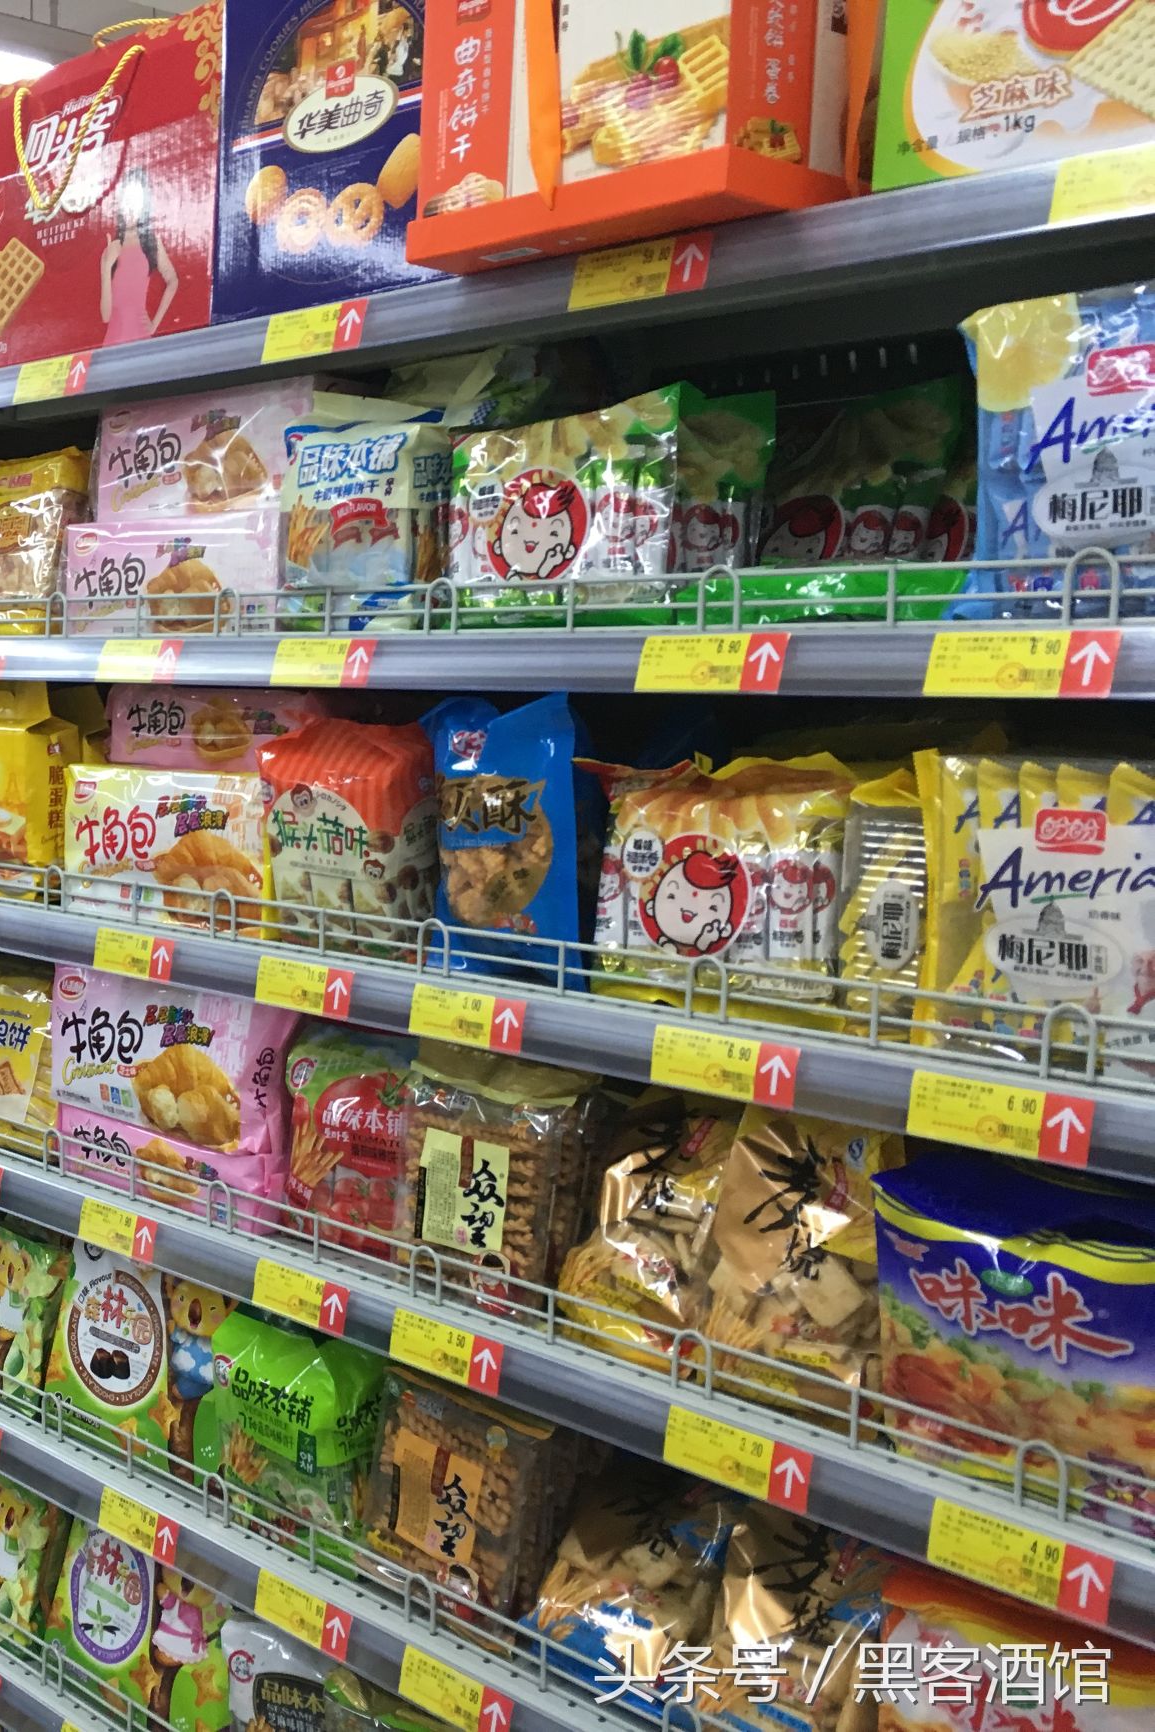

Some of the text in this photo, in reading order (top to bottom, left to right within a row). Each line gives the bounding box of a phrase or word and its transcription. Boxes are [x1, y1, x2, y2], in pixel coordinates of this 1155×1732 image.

[293, 89, 386, 141] 华美曲奇
[448, 36, 482, 163] 曲奇饼干
[968, 70, 1063, 114] 芝麻味
[1003, 112, 1036, 134] 1kg
[107, 427, 183, 490] 牛角包
[298, 433, 408, 489] 品味本铺
[1049, 485, 1143, 523] 梅尼耶
[74, 552, 146, 611] 牛角包
[126, 698, 186, 738] 牛角包
[75, 804, 157, 866] 牛角包
[997, 932, 1089, 970] 梅尼耶
[61, 1006, 144, 1065] 牛角包
[231, 1365, 315, 1431] 品味本铺
